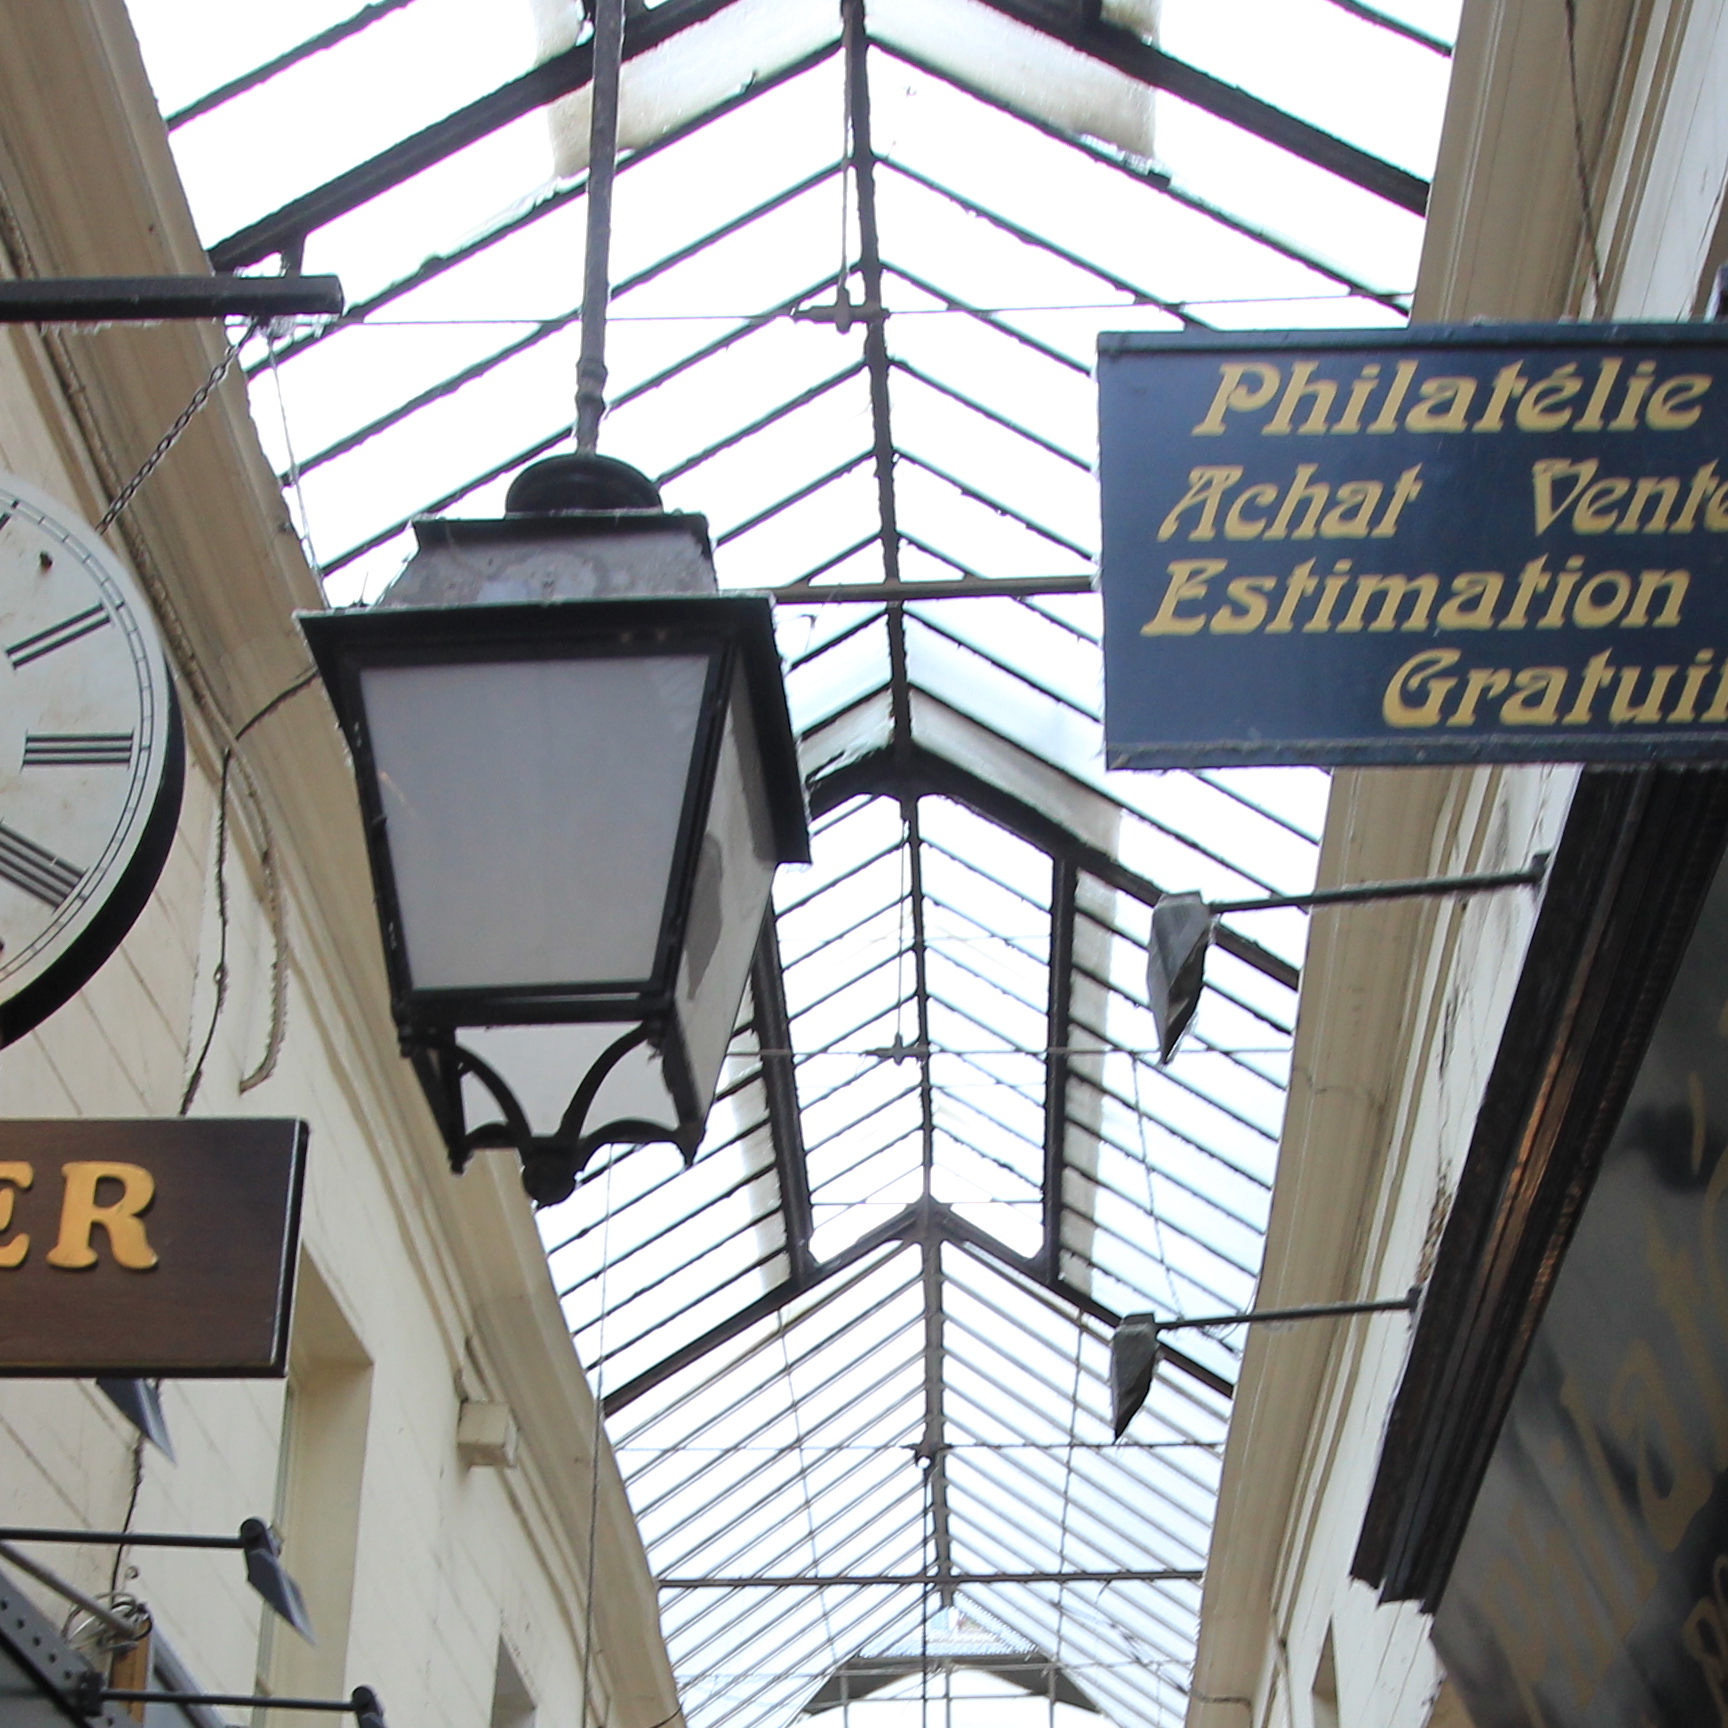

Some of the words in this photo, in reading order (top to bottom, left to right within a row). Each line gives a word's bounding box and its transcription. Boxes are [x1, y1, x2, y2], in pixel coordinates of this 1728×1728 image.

[1191, 356, 1713, 439] Philatélie
[1156, 462, 1423, 543] Achat
[1141, 553, 1691, 637] Estimation
